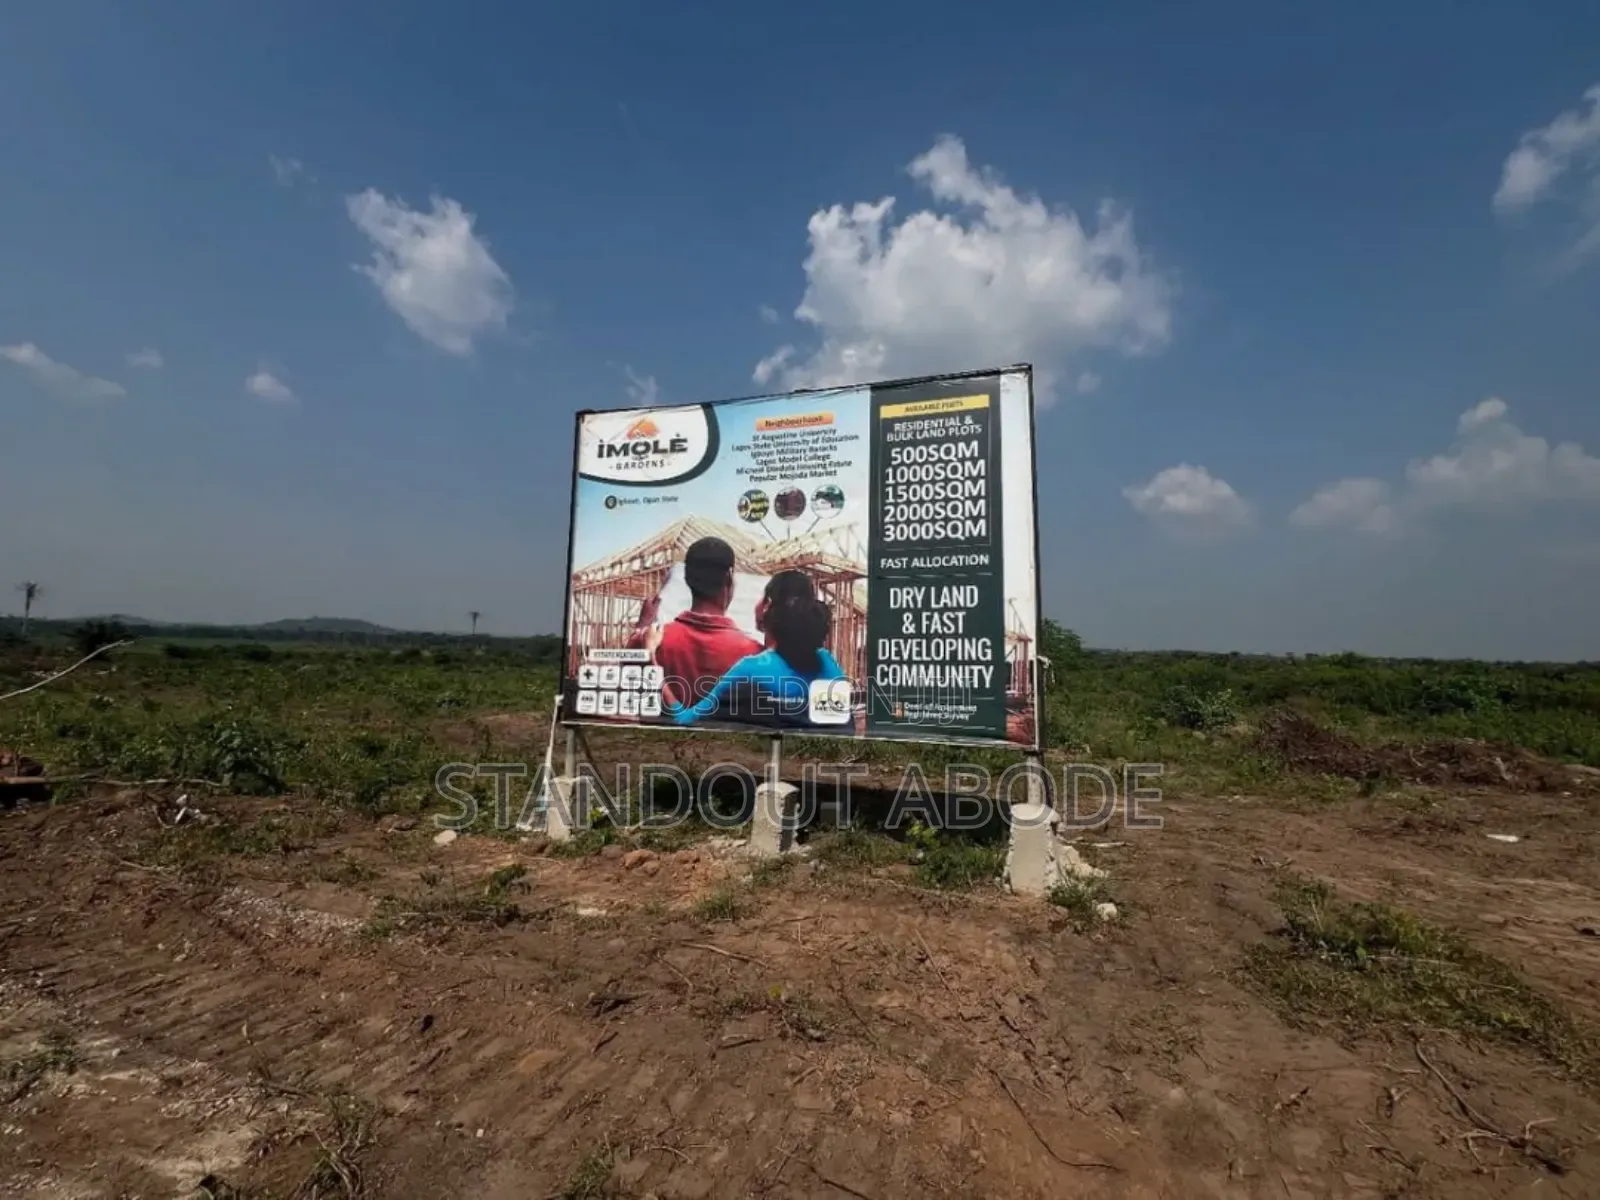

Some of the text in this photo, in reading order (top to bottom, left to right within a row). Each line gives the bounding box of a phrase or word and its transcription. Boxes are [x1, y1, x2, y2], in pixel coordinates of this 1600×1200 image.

[799, 428, 837, 438] University
[886, 424, 983, 442] BULK LAND PLOTS
[893, 414, 974, 432] RESIDENTIAL &
[772, 439, 810, 448] University
[890, 440, 979, 465] 500SQM
[615, 459, 665, 471] GARDENS
[884, 459, 986, 484] 1000SQM
[884, 479, 986, 503] 1500SQM
[883, 499, 986, 523] 2000SQM
[883, 519, 987, 542] 3000SQM
[880, 554, 990, 569] FAST ALLOCATION
[889, 585, 979, 609] DRY LAND
[901, 611, 967, 635] & FAST
[877, 637, 993, 661] DEVELOPING
[876, 664, 995, 689] COMMUNITY
